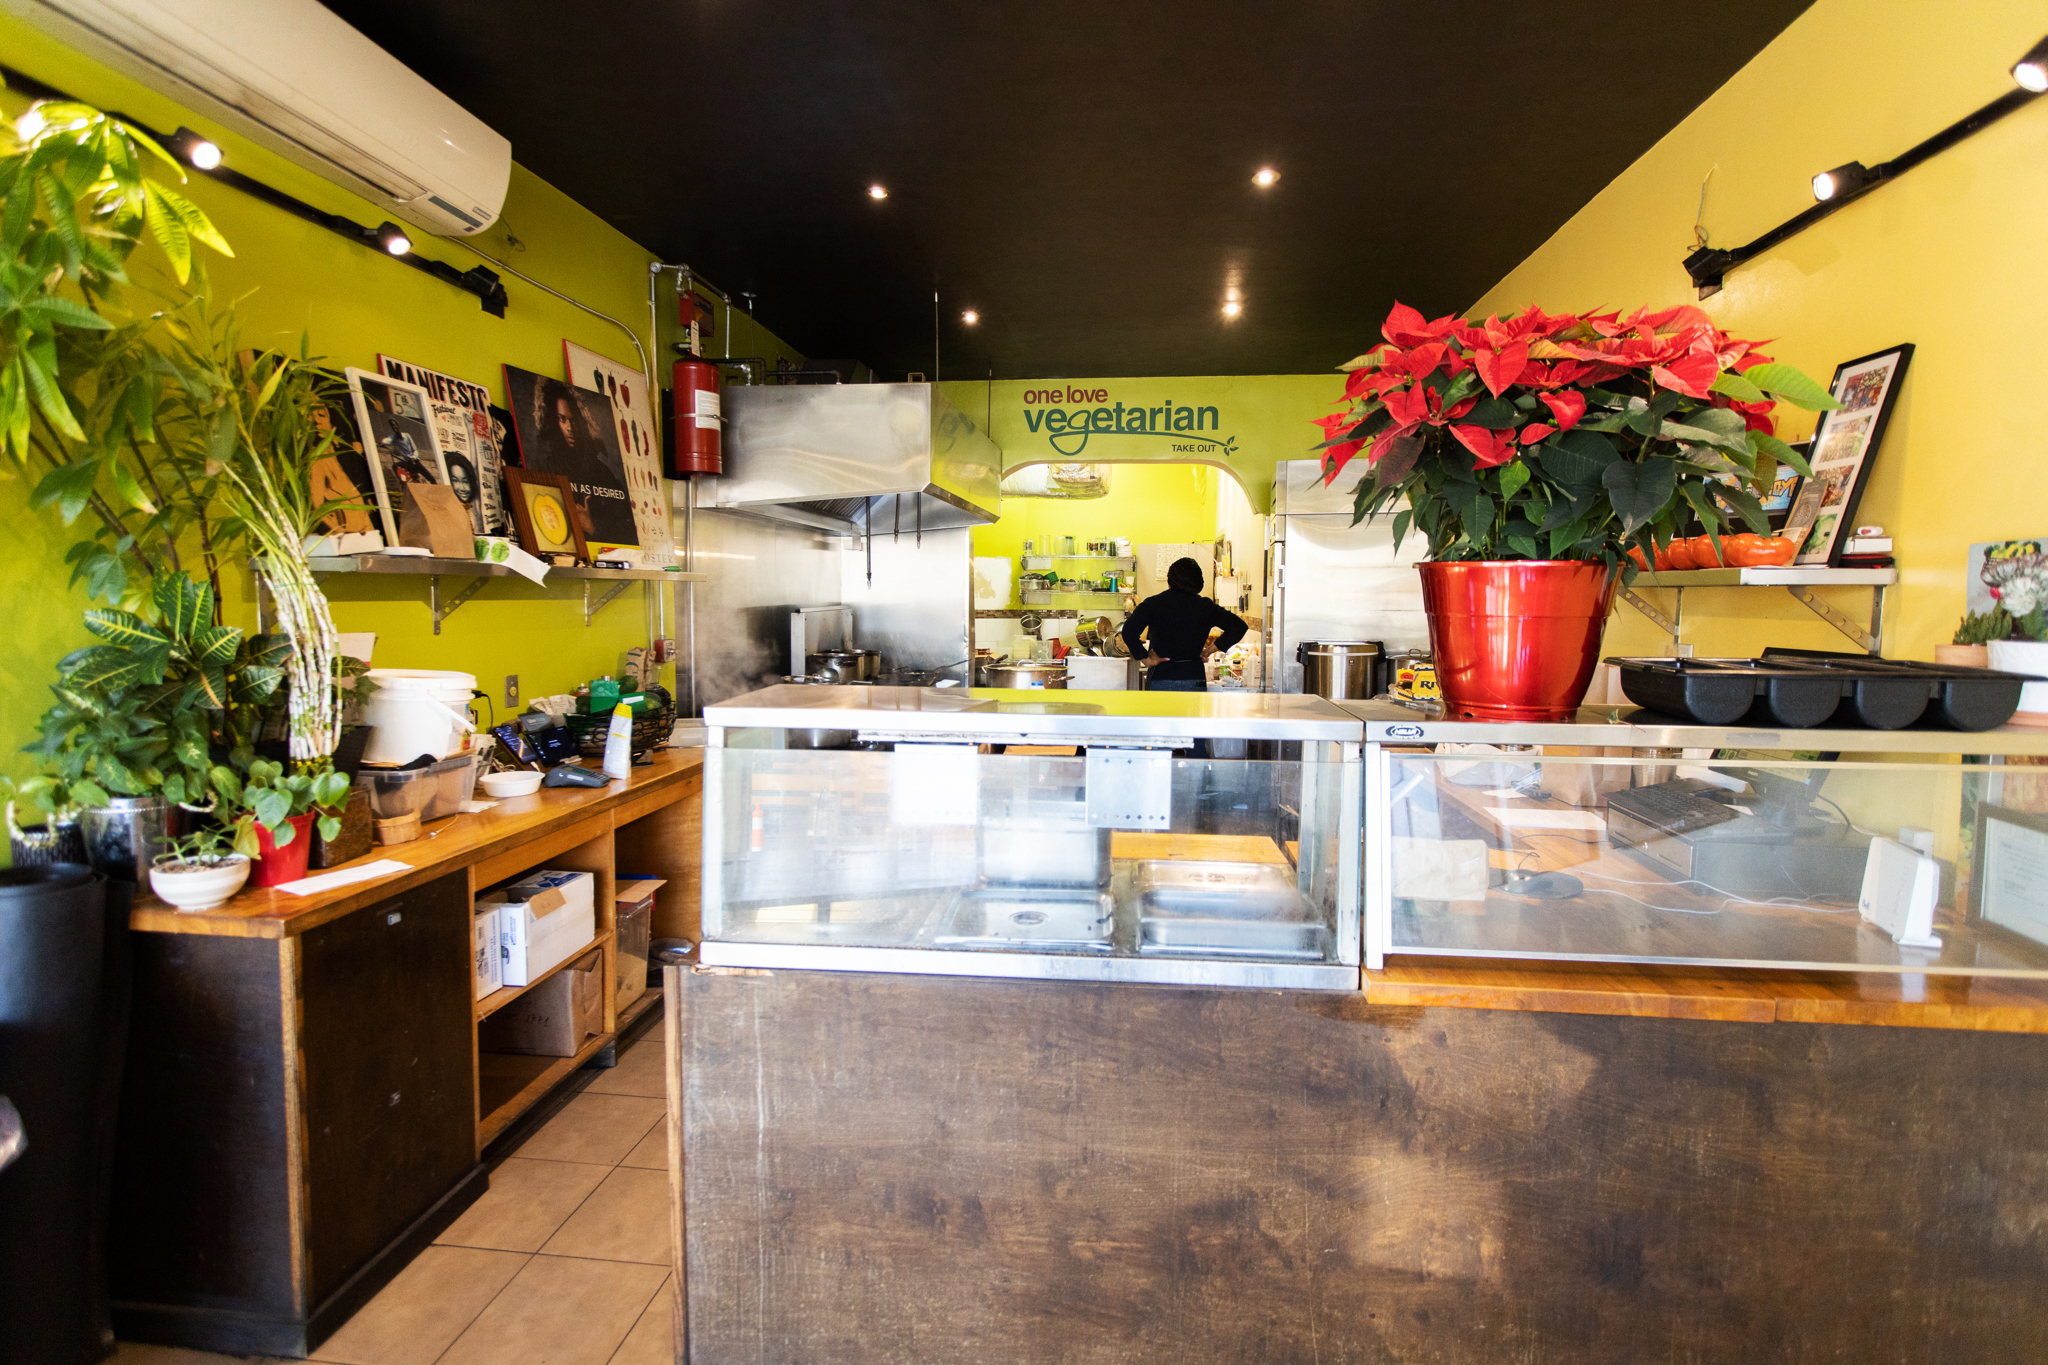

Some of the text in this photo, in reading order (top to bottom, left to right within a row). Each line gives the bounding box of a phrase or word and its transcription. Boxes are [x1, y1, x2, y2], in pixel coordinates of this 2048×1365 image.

[1023, 385, 1108, 405] one love
[1023, 400, 1219, 456] vegetarian
[1171, 444, 1216, 453] TAKE OUT
[580, 484, 591, 495] AS
[593, 486, 625, 500] DESIRED
[643, 552, 674, 564] OSTER
[1420, 680, 1437, 690] RI
